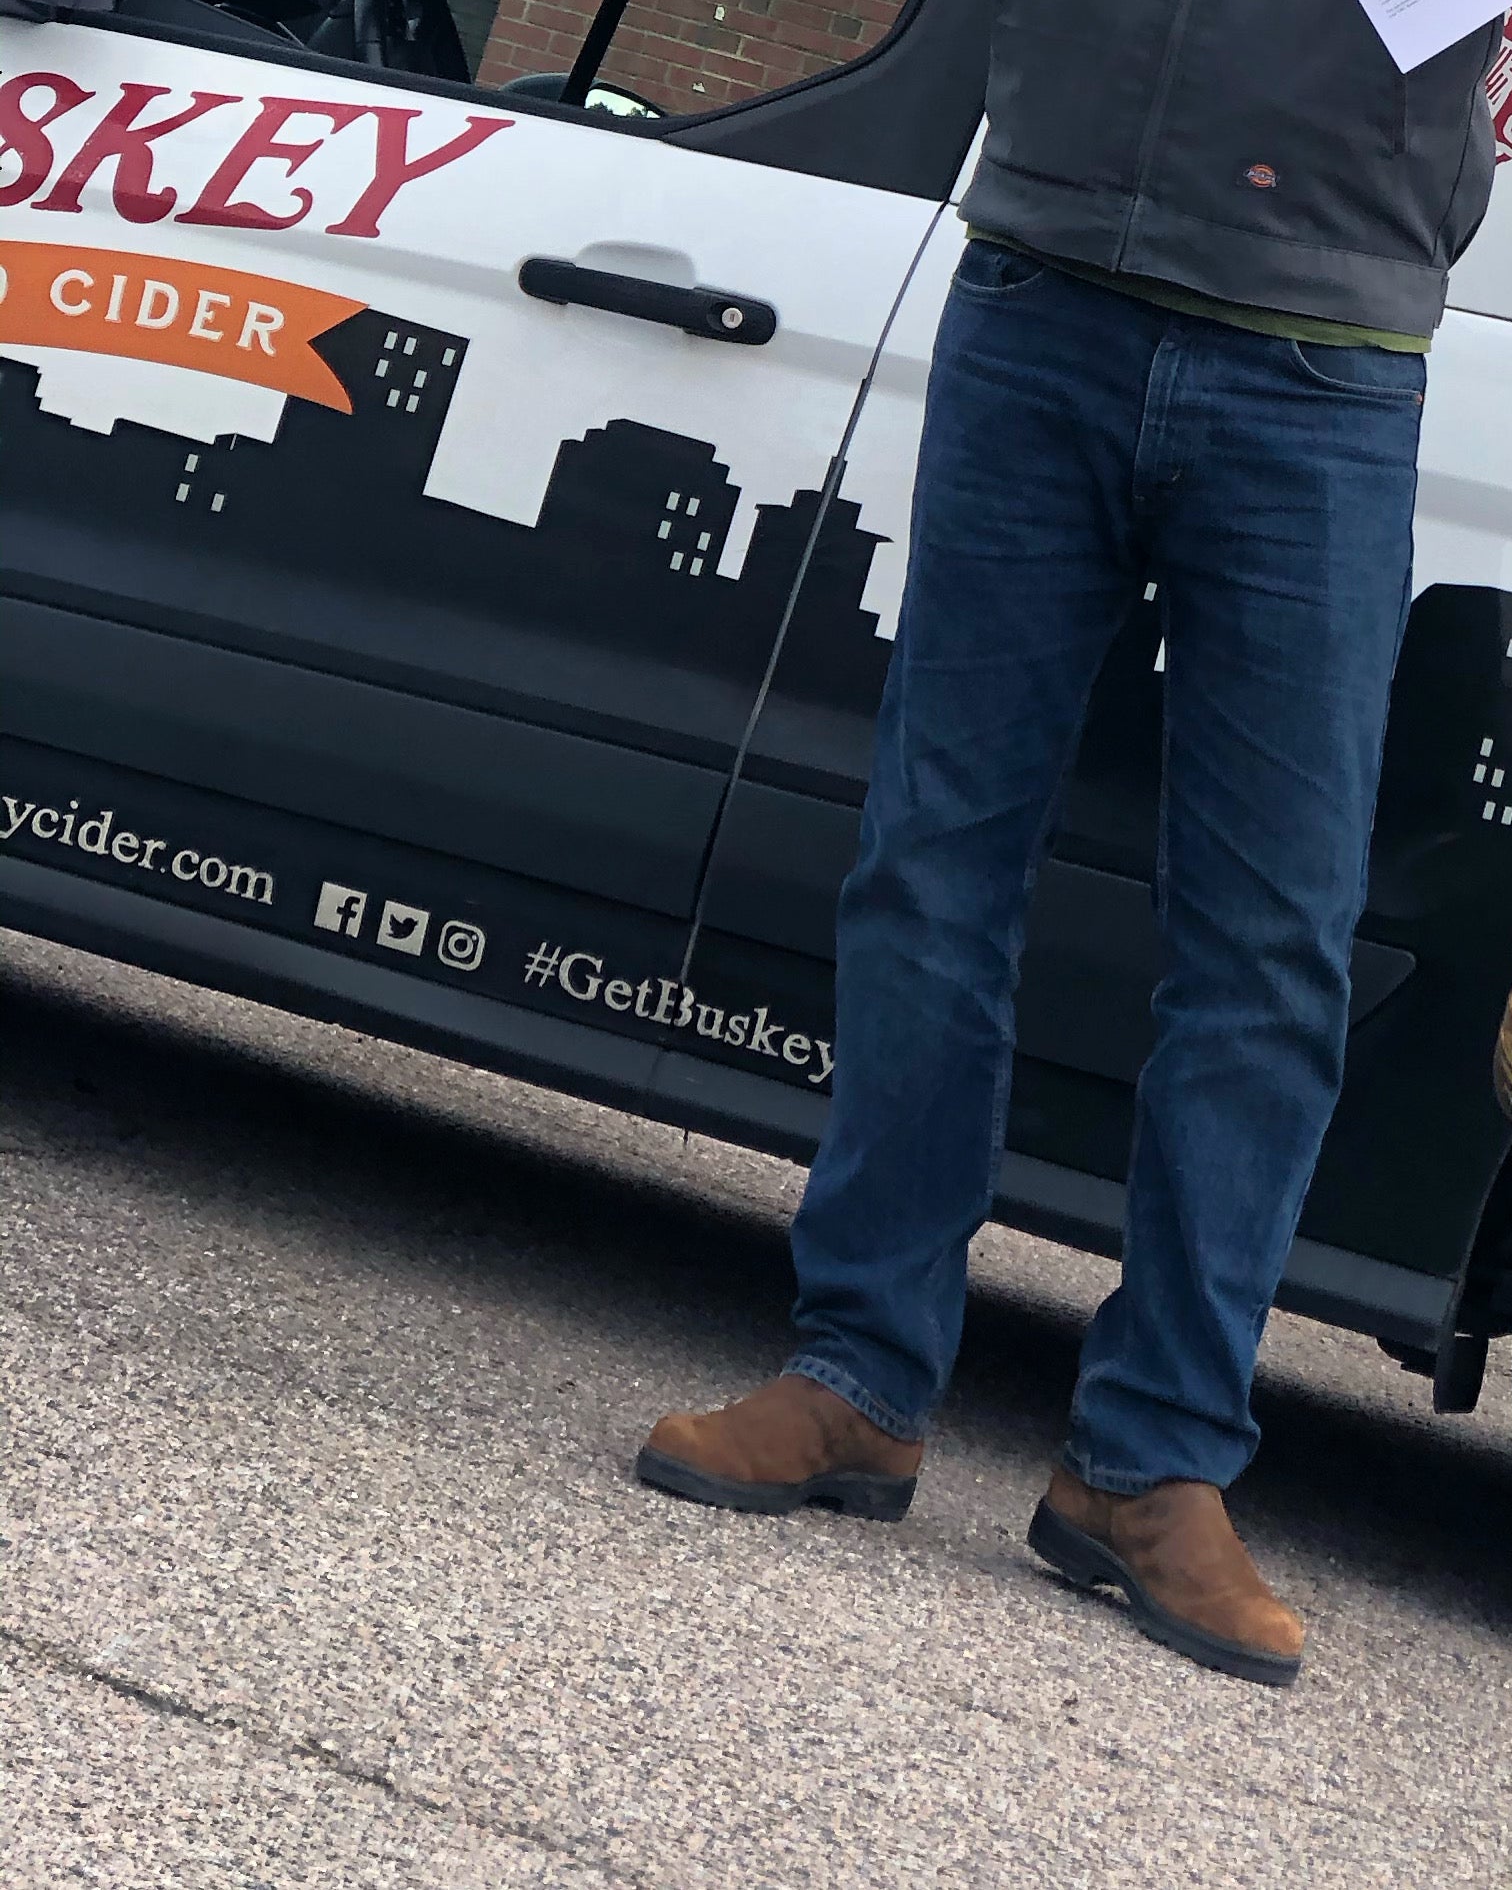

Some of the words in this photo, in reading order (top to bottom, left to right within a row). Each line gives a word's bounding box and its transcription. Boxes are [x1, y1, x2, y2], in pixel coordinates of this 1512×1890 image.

[49, 269, 285, 357] CIDER
[0, 796, 273, 905] ycider.com
[525, 941, 836, 1084] #GetBuskey
